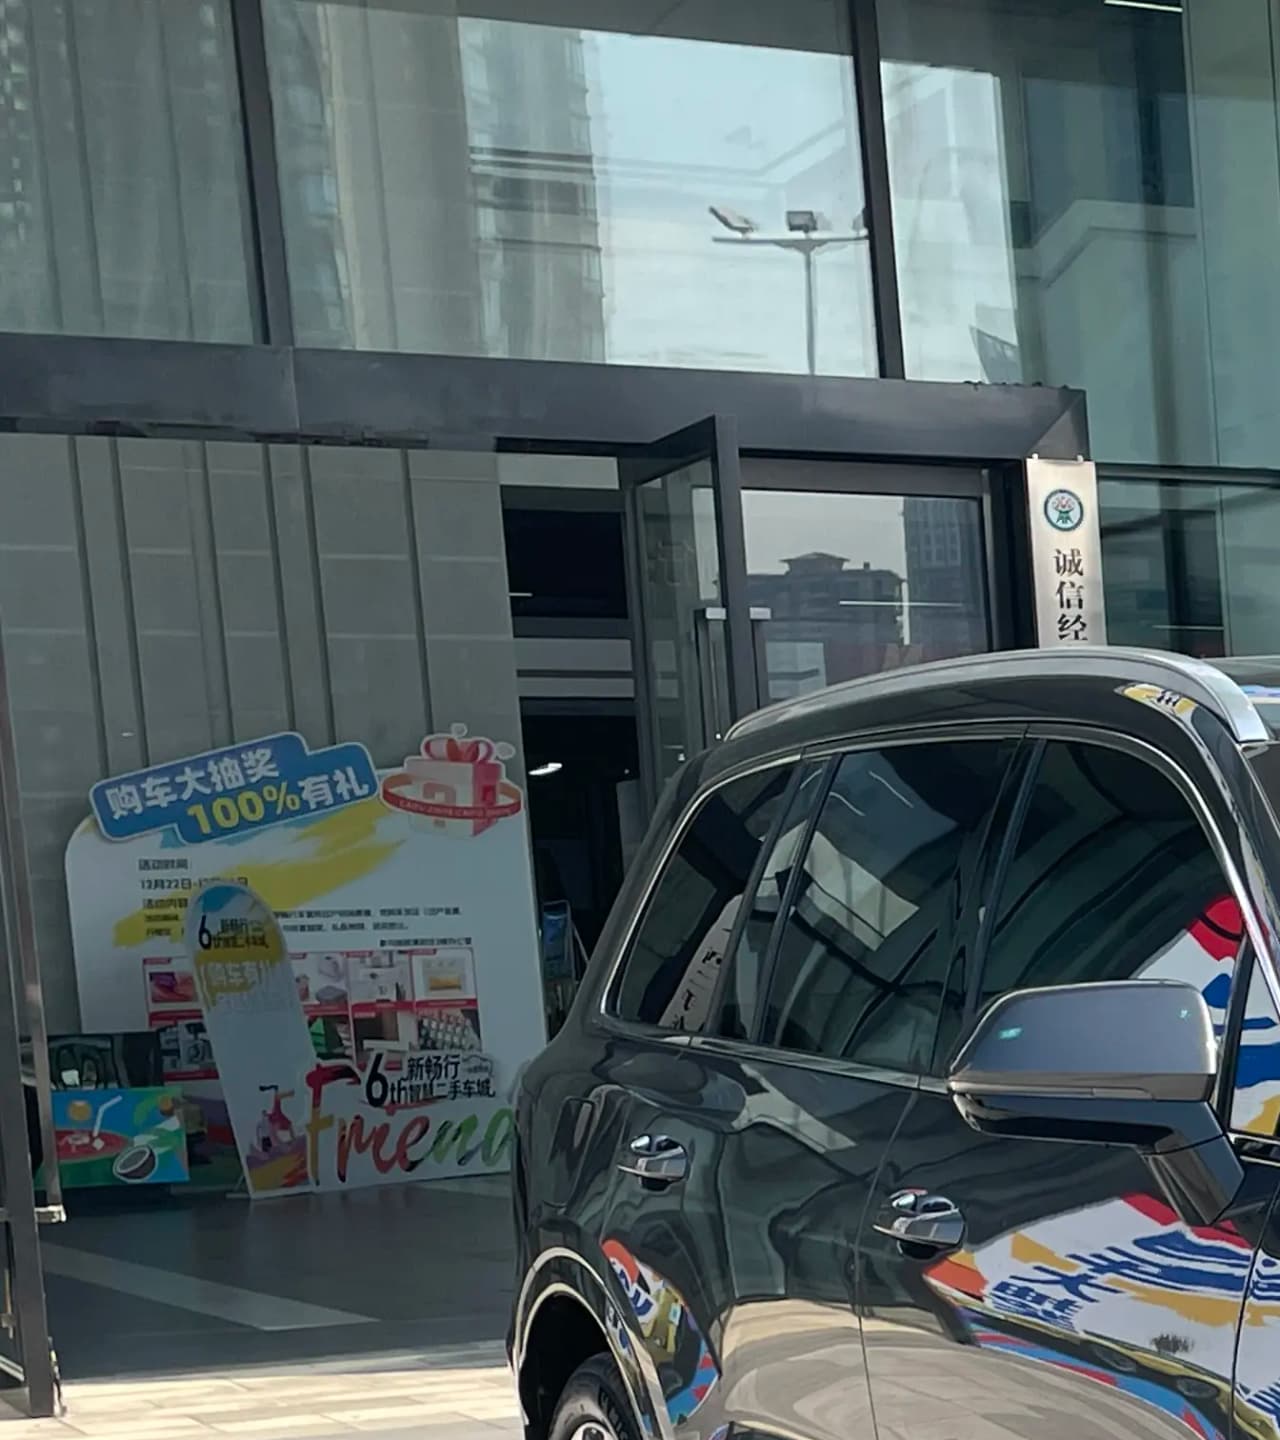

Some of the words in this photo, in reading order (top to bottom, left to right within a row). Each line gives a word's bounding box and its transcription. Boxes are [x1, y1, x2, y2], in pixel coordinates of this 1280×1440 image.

[1053, 548, 1088, 641] 诚信经
[105, 748, 280, 820] 购车大抽奖
[406, 1054, 461, 1081] 新畅行
